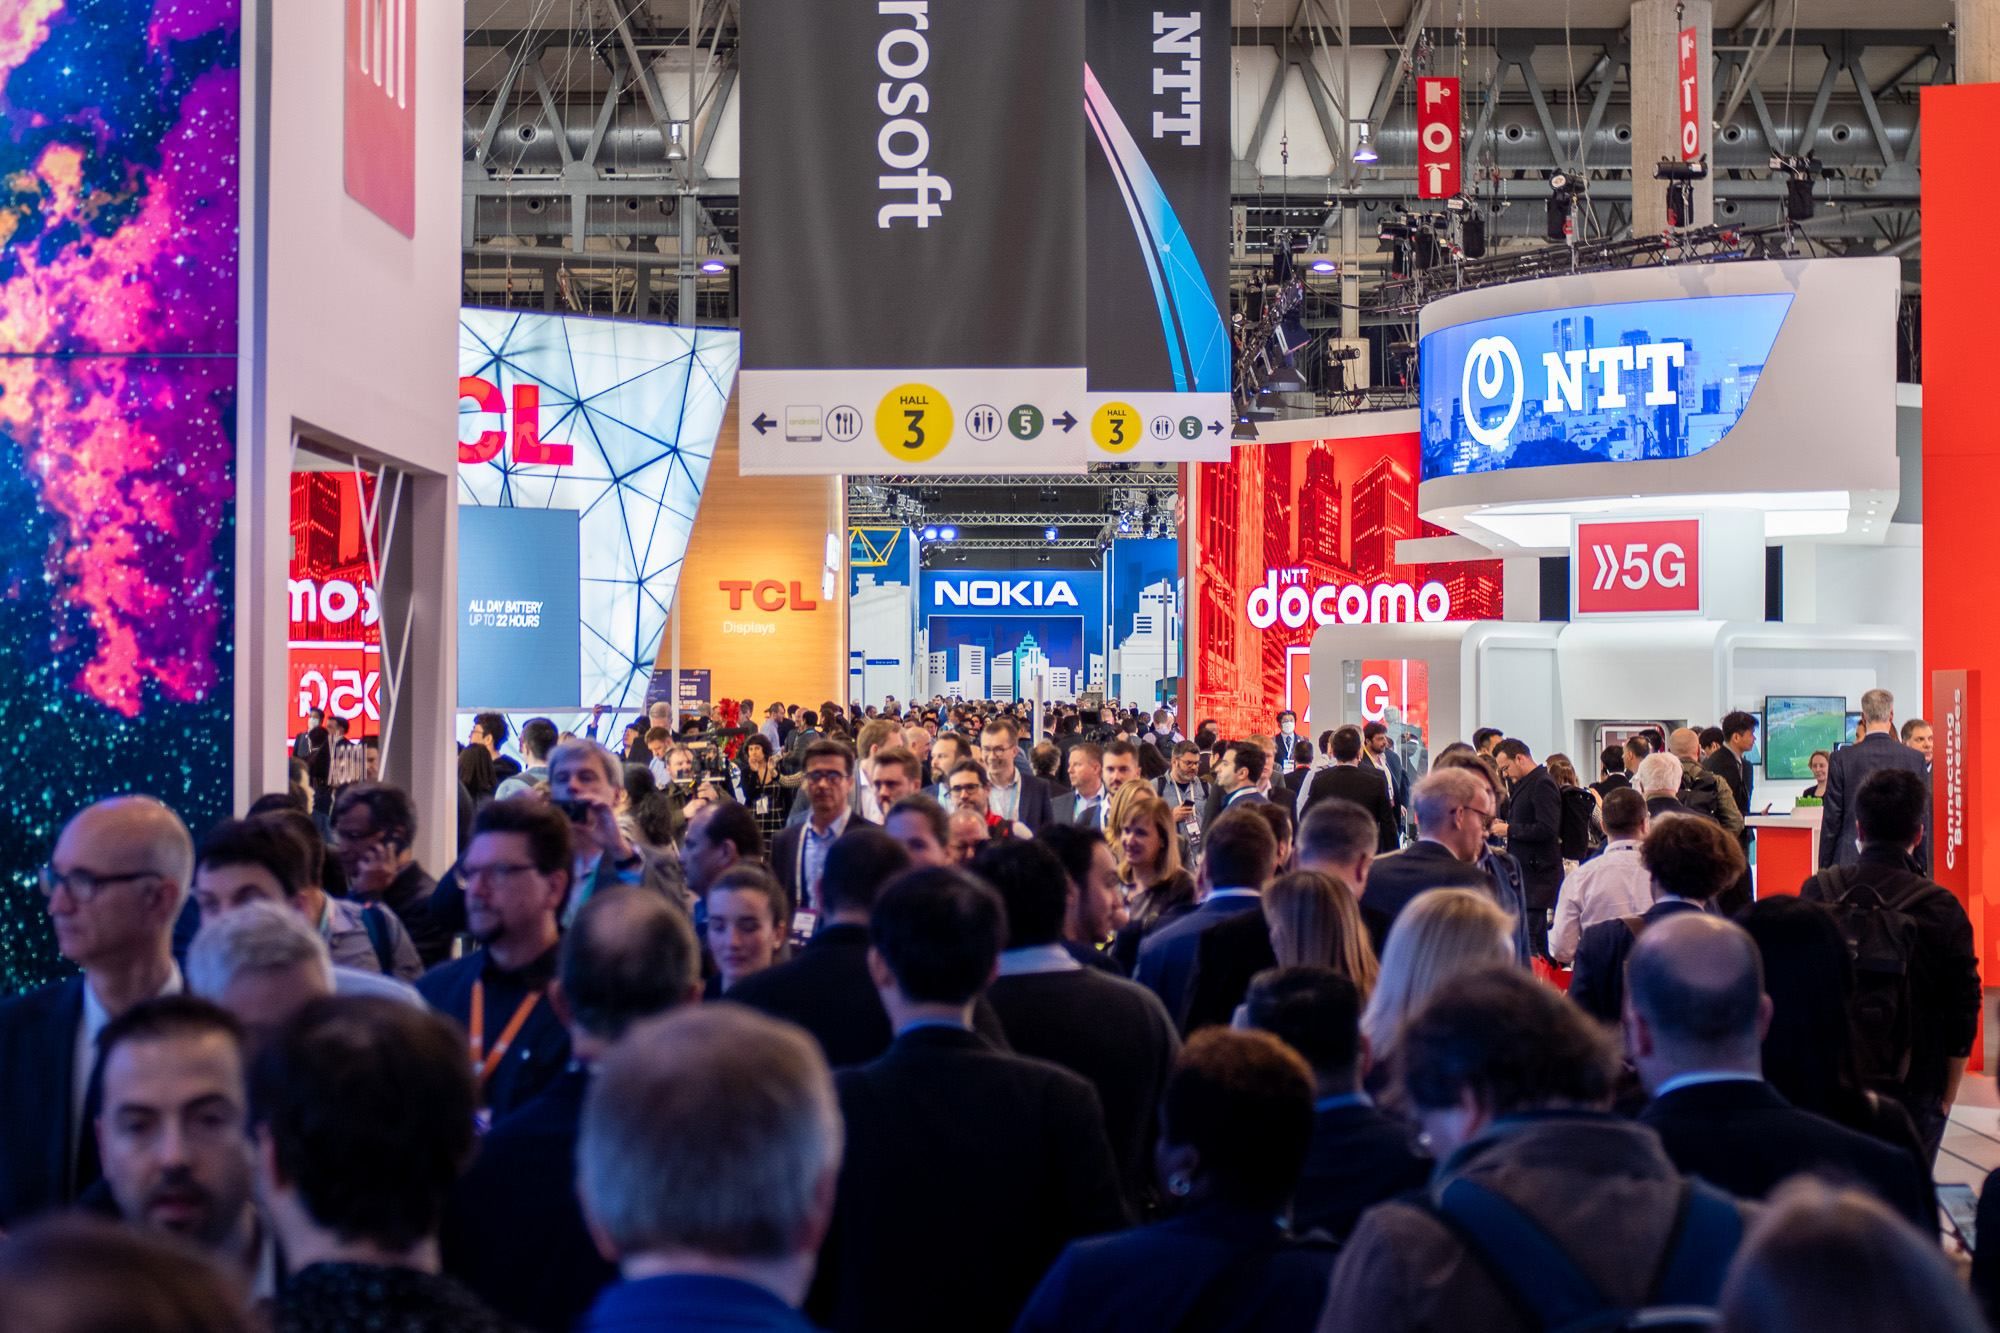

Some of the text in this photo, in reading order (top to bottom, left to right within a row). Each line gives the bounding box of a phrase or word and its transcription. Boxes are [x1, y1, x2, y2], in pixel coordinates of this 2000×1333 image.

[1152, 11, 1201, 146] NTT
[878, 0, 952, 228] rosoft
[1542, 341, 1685, 413] NTT
[900, 396, 929, 405] HALL
[902, 410, 925, 449] 3
[1020, 415, 1032, 436] 5
[1109, 419, 1124, 445] 3
[1186, 423, 1195, 437] 5
[1281, 568, 1309, 583] NTT
[719, 579, 817, 612] TCL
[934, 580, 1079, 606] NOKIA
[1247, 569, 1451, 629] docomo
[469, 600, 544, 614] ALL DAY BATTERY
[469, 613, 541, 628] UP TO 22 HOURS
[723, 620, 776, 635] Displays
[1954, 688, 1963, 846] Businesses
[1945, 712, 1955, 870] Connecting
